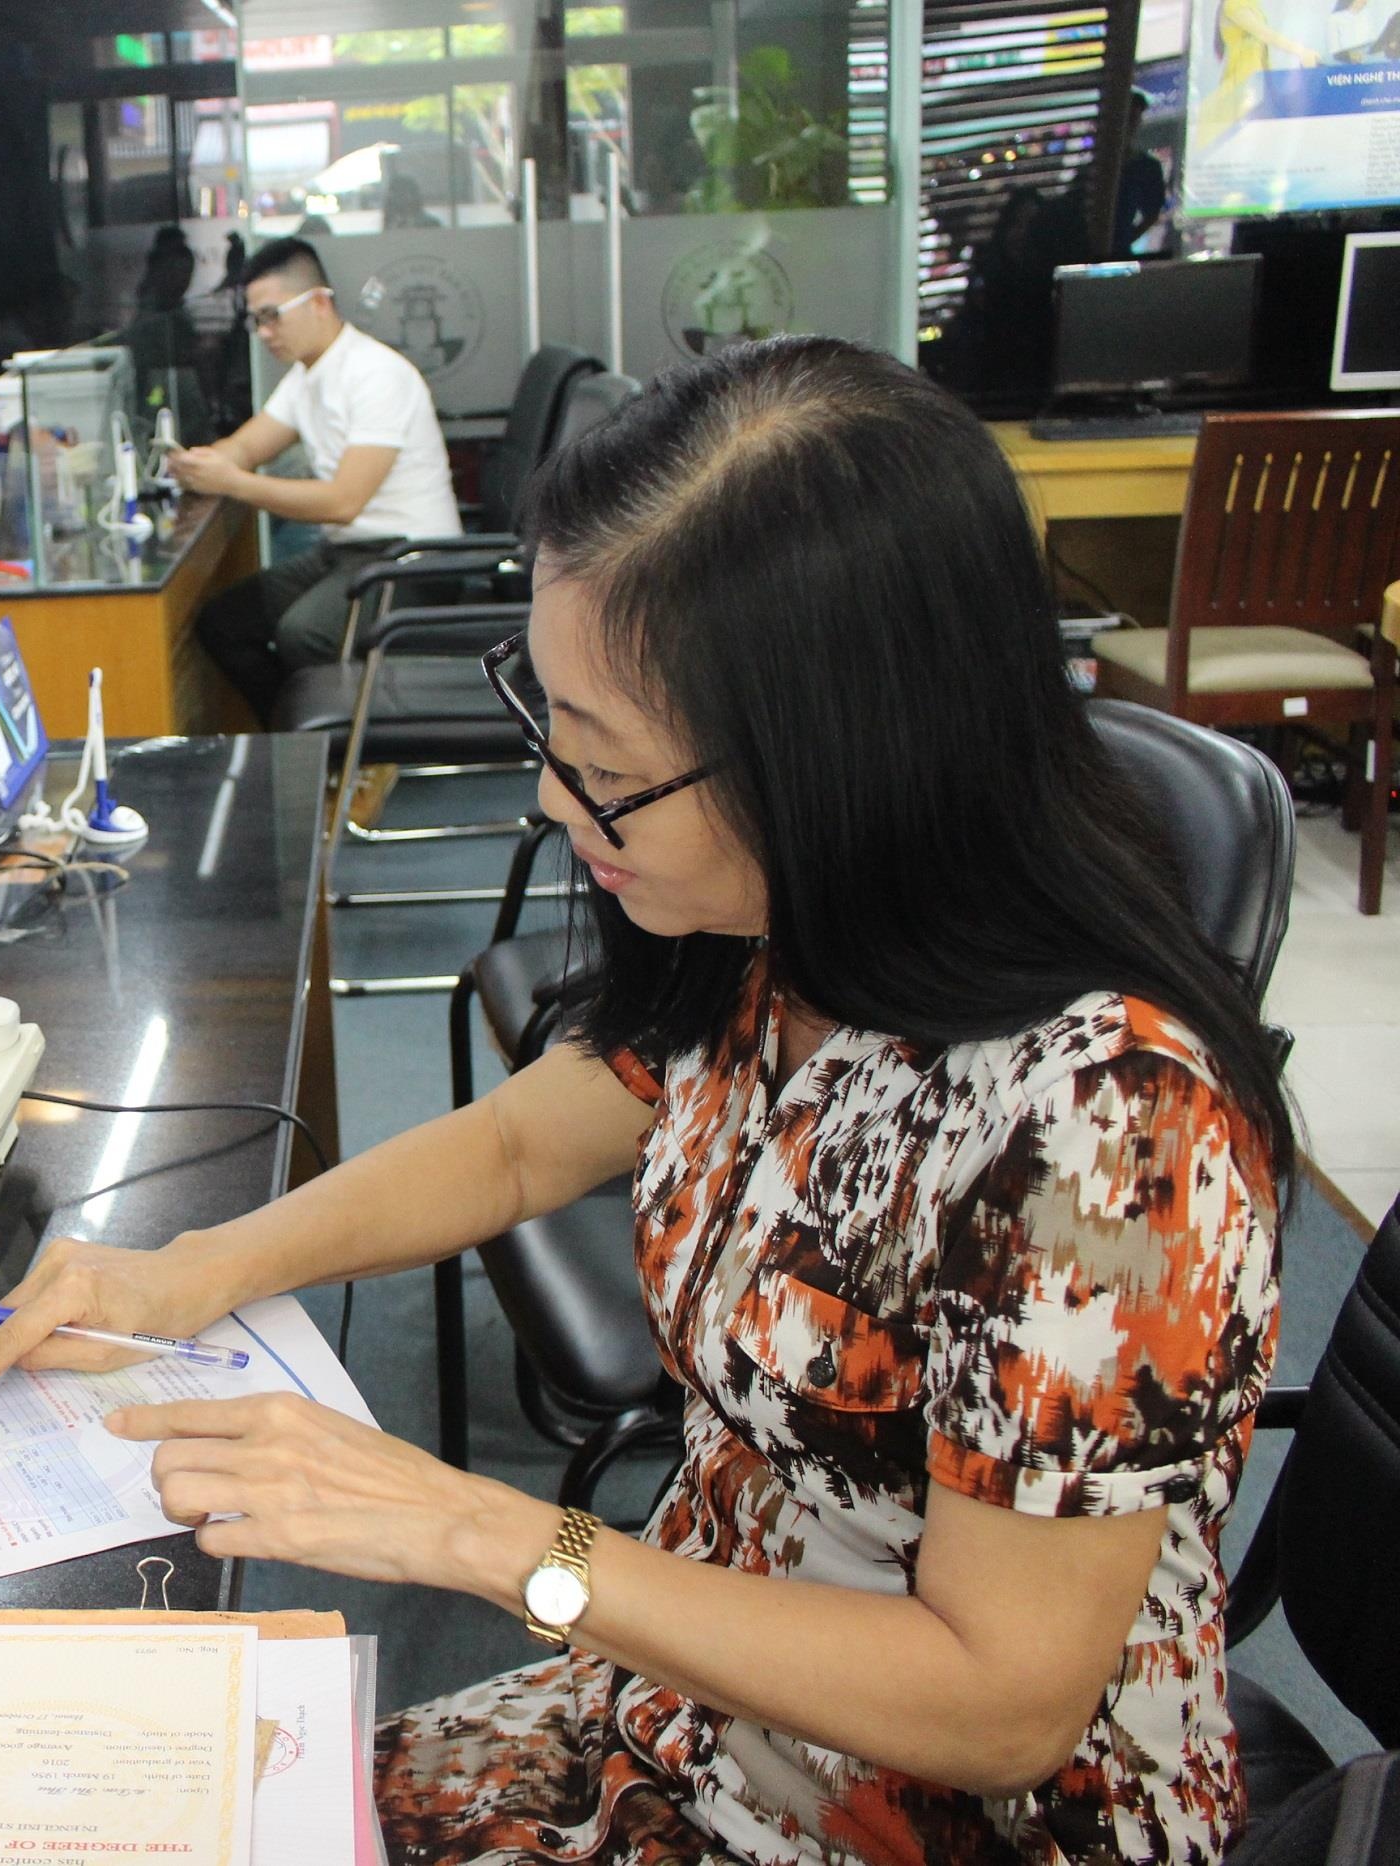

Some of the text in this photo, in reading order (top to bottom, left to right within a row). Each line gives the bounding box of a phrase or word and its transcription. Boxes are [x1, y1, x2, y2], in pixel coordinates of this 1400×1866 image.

[4, 1839, 36, 1850] OF
[42, 1841, 138, 1853] DEGREE
[145, 1843, 193, 1853] THE
